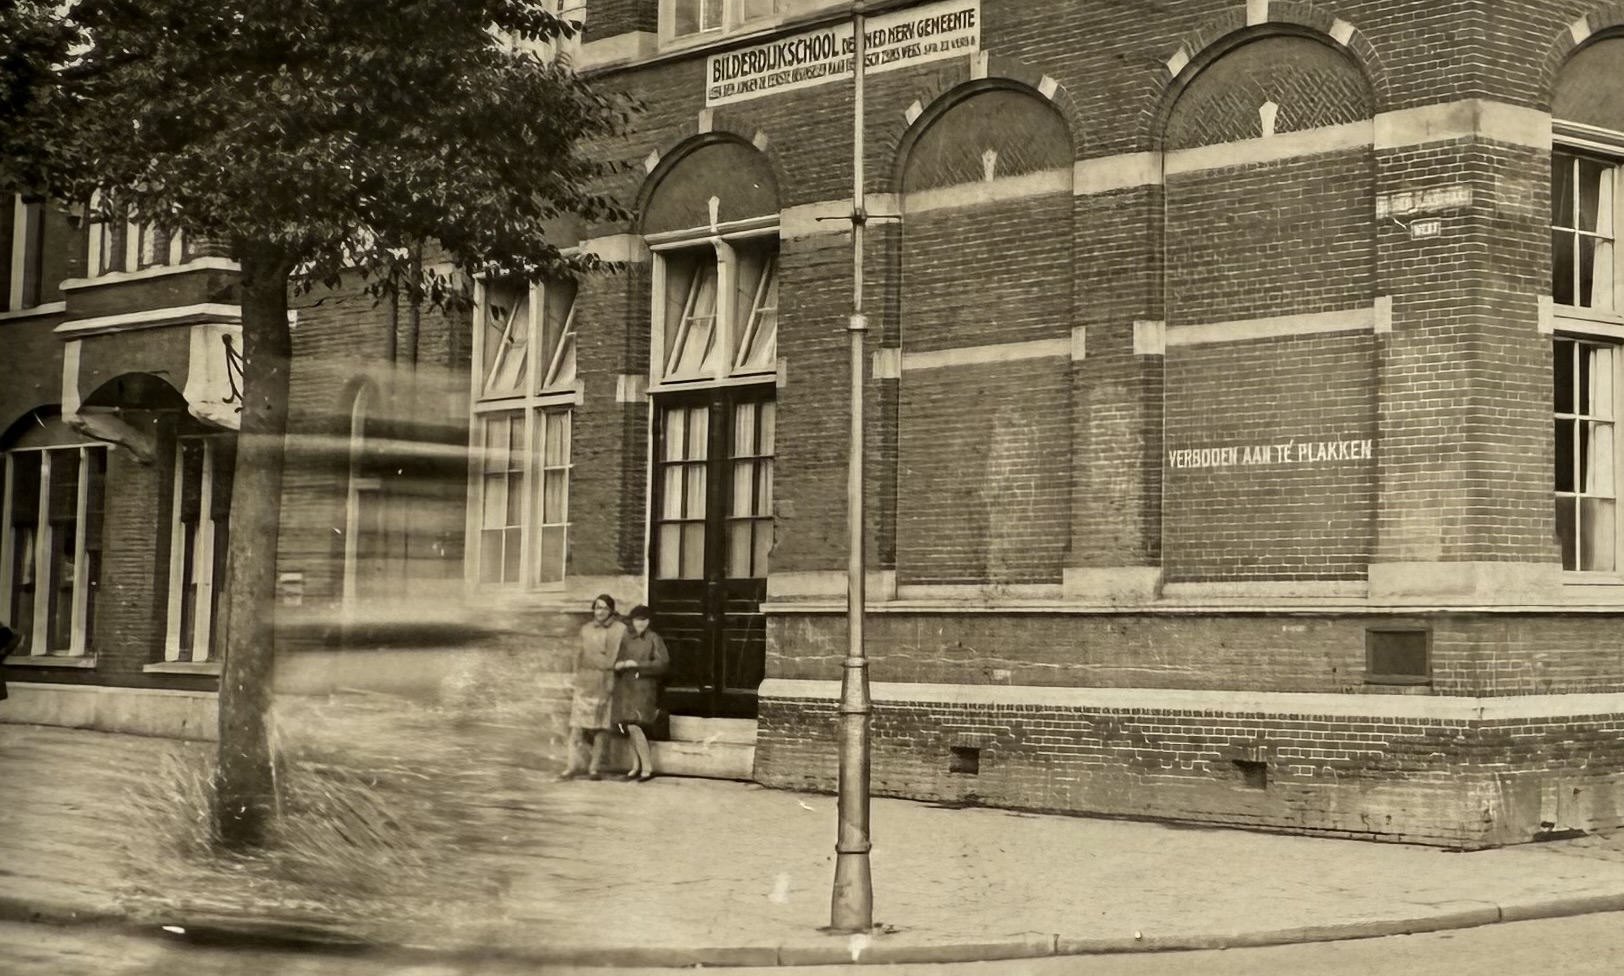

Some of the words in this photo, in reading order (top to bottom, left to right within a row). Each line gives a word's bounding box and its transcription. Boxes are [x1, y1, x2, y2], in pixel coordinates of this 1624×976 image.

[713, 32, 839, 83] BILDERDIJKSCHOOL
[917, 8, 976, 39] GEMEENTE
[1168, 446, 1237, 468] VERBODEN
[1242, 445, 1271, 465] AAN
[1298, 439, 1372, 463] PLAKKEN
